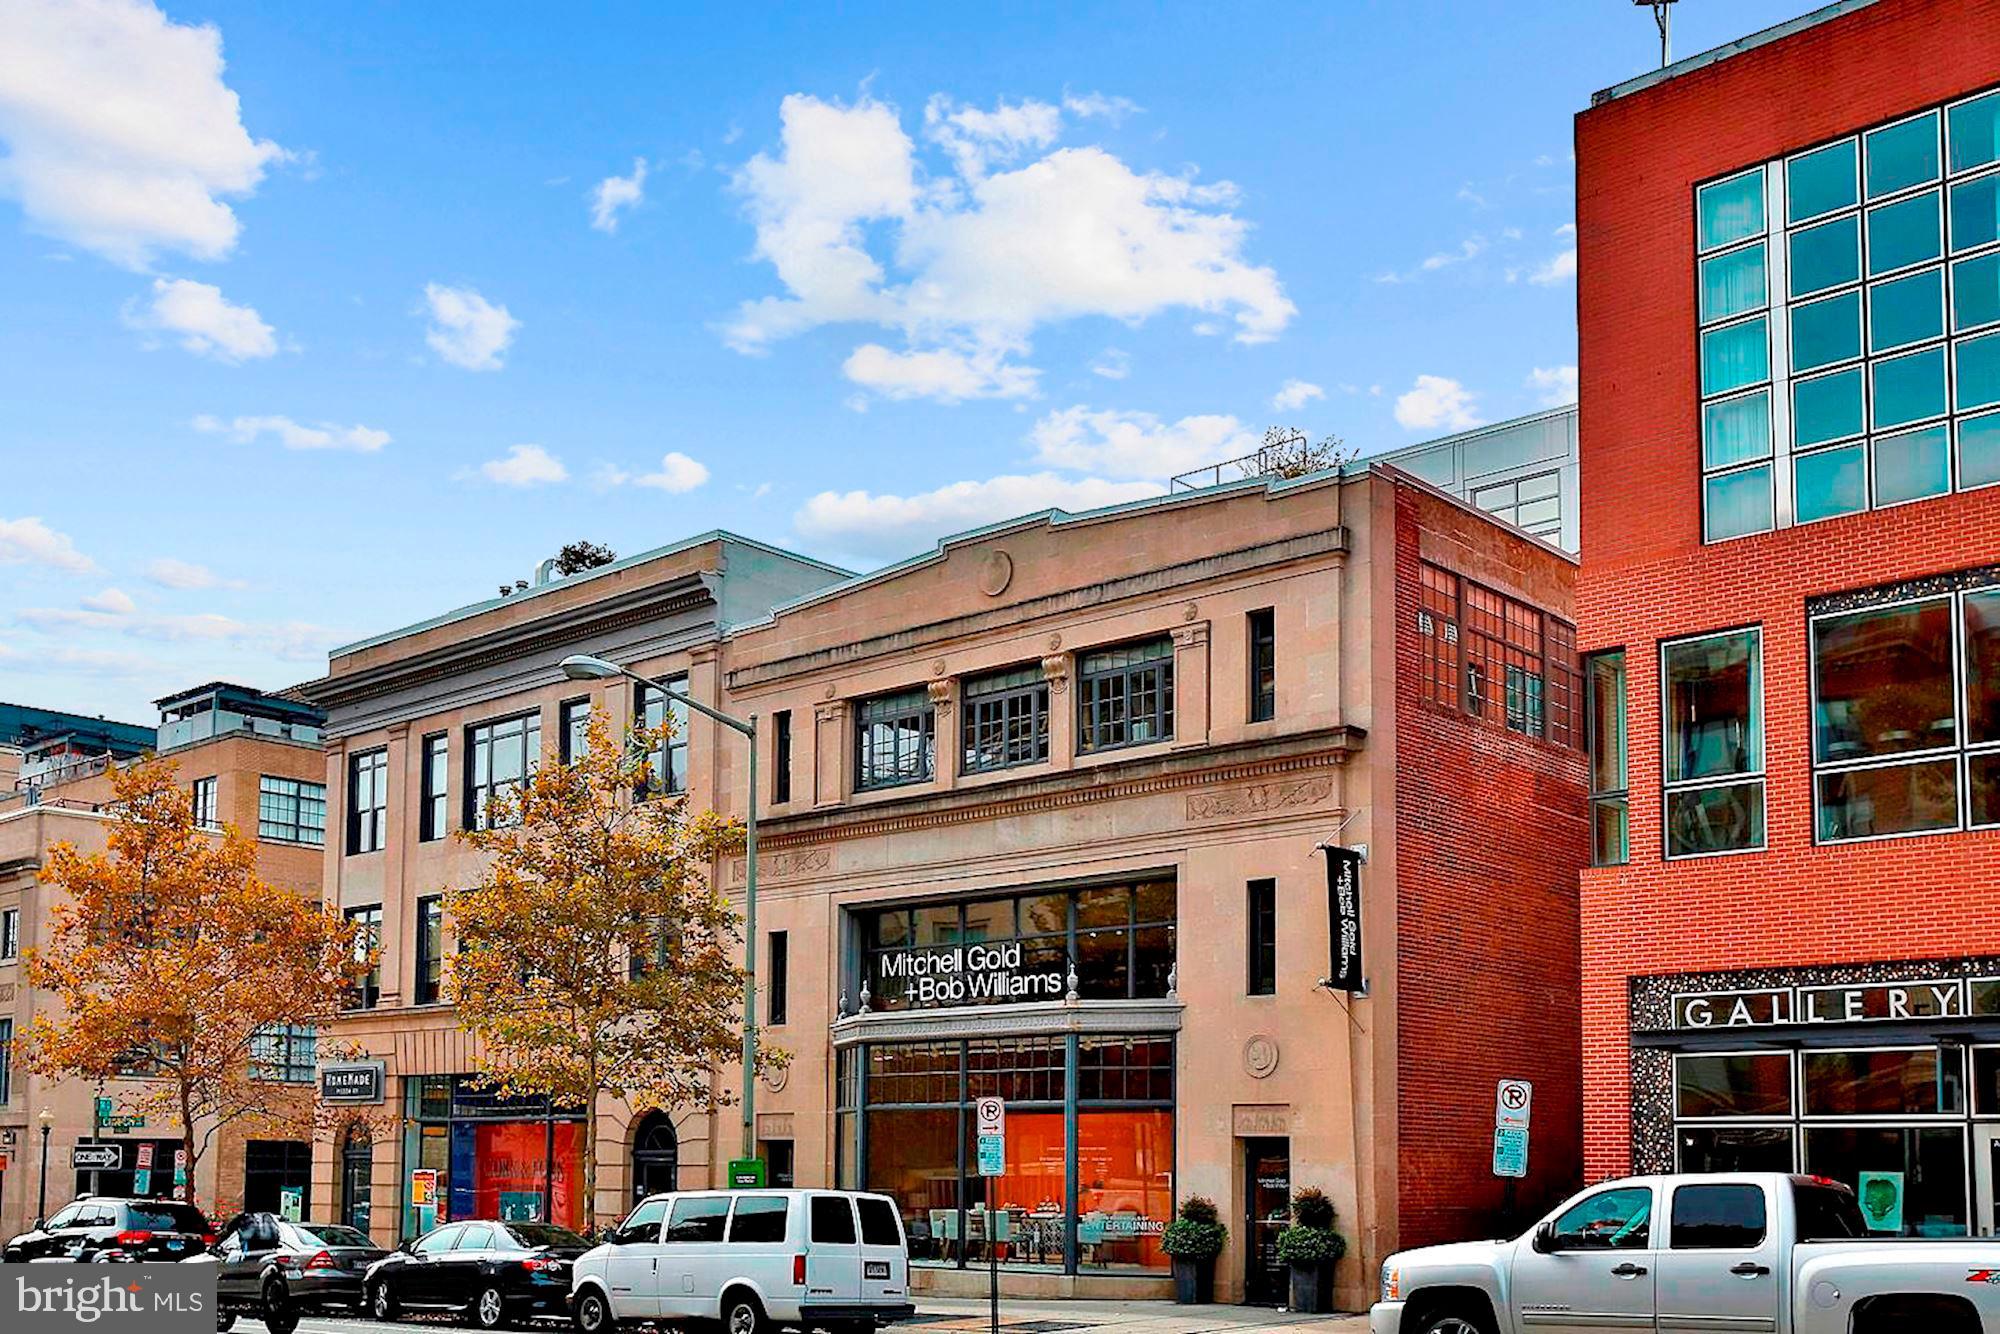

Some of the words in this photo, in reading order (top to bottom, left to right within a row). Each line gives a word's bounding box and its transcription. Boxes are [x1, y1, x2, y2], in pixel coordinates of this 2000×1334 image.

[881, 948, 963, 978] Mitchell
[967, 943, 1020, 971] Gold
[904, 976, 965, 1001] +Bob
[967, 971, 1062, 998] Williams
[1684, 986, 1958, 1027] GALLERY
